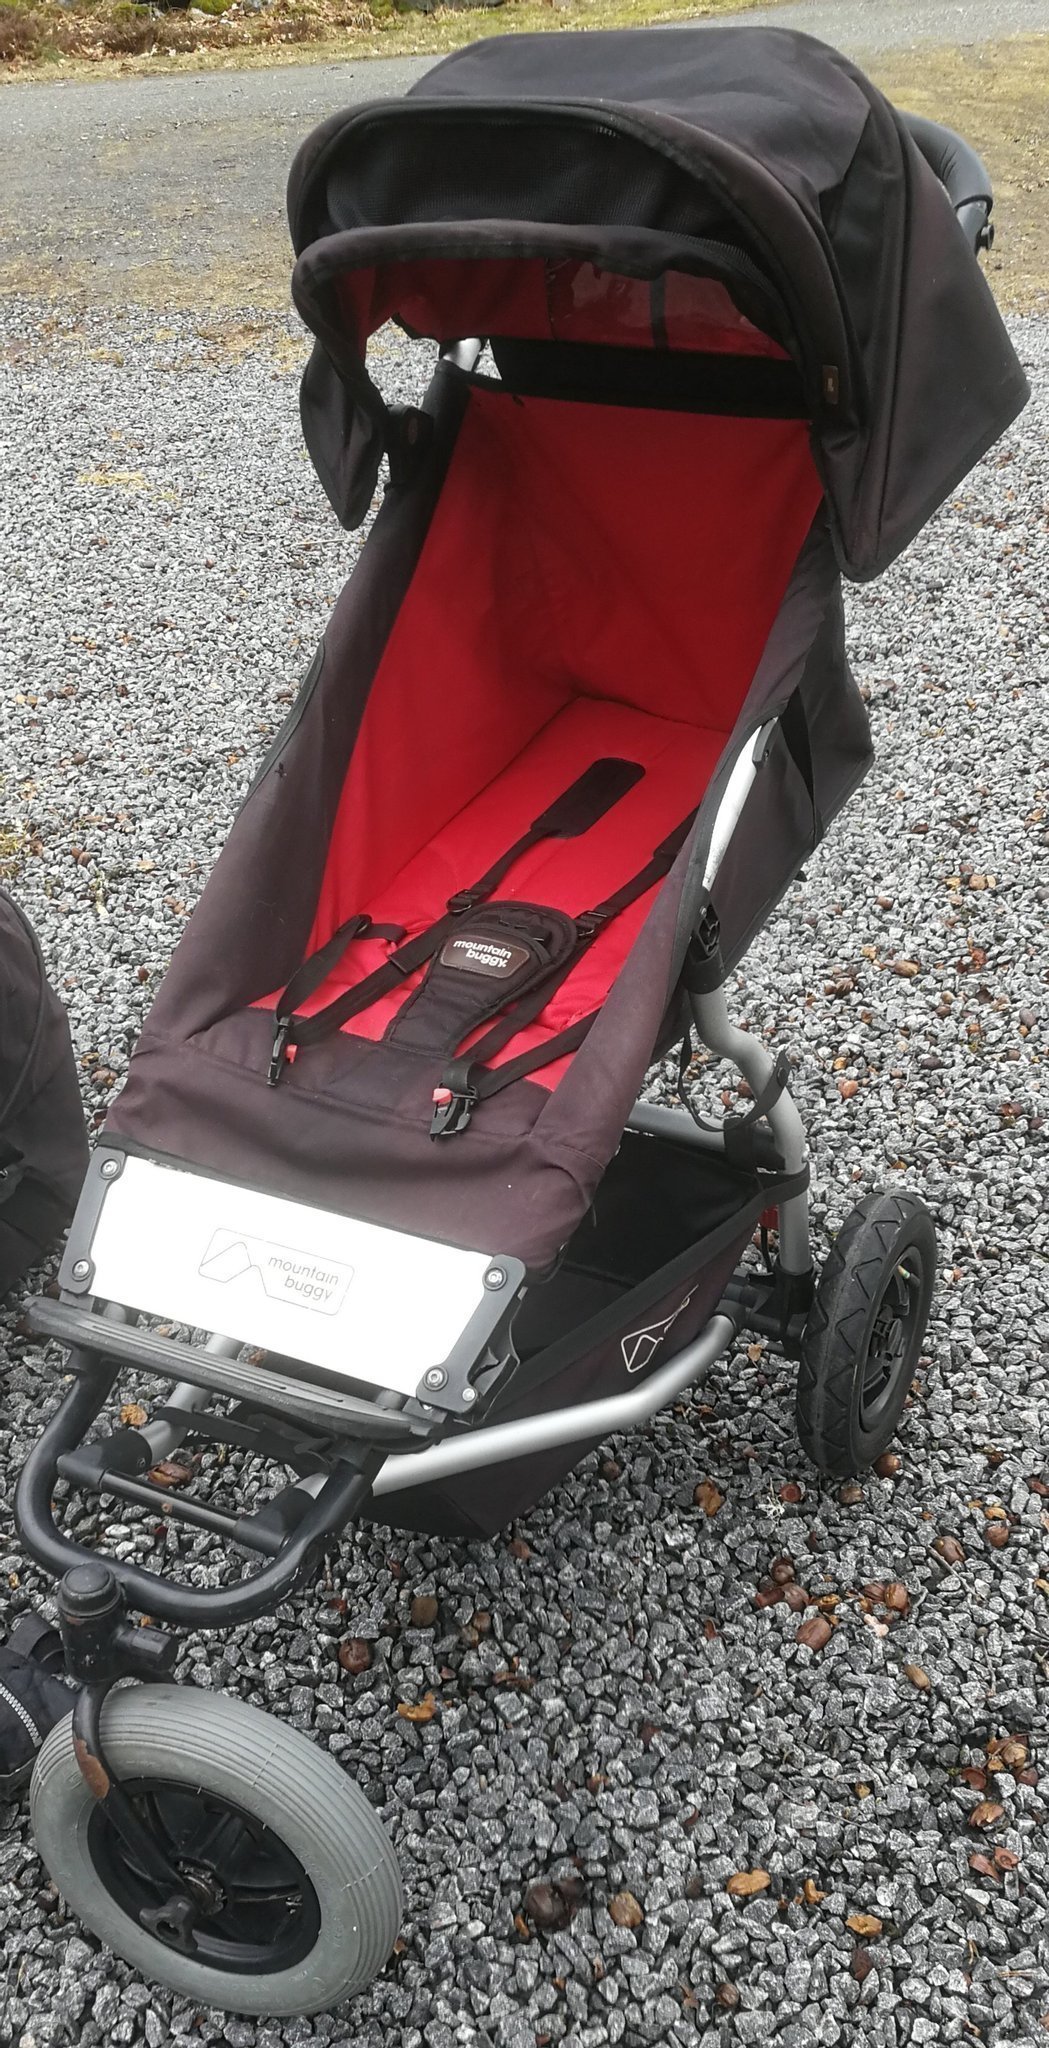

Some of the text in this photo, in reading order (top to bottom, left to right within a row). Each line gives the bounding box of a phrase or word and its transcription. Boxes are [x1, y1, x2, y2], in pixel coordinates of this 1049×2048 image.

[453, 940, 512, 959] mountain
[269, 1257, 339, 1285] mountain
[284, 1275, 333, 1301] buggy
